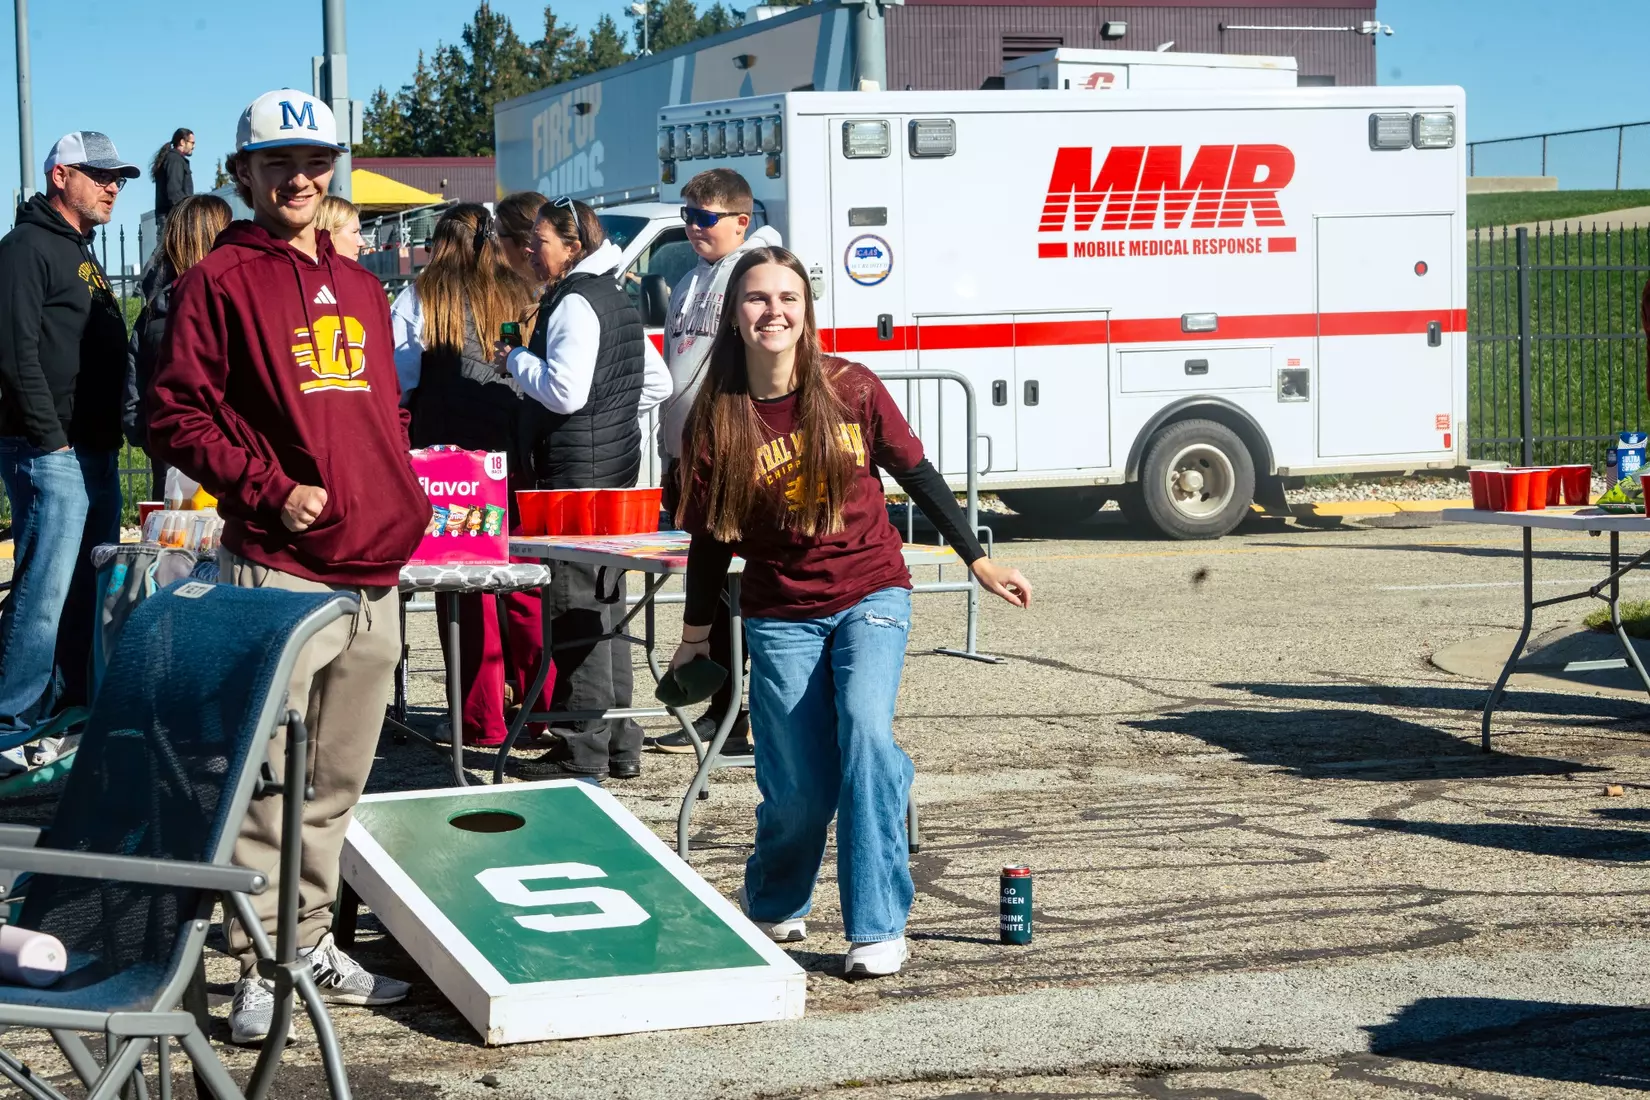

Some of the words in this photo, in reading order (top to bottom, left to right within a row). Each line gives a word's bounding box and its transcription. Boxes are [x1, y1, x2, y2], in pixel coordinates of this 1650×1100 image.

[279, 100, 318, 130] M
[533, 91, 573, 181] FIRE
[574, 81, 602, 150] UP
[1038, 143, 1295, 232] MMR
[1073, 240, 1126, 258] MOBILE
[1129, 239, 1189, 257] MEDICAL
[1193, 237, 1262, 255] RESPONSE
[491, 456, 502, 470] 18
[474, 861, 652, 933] S
